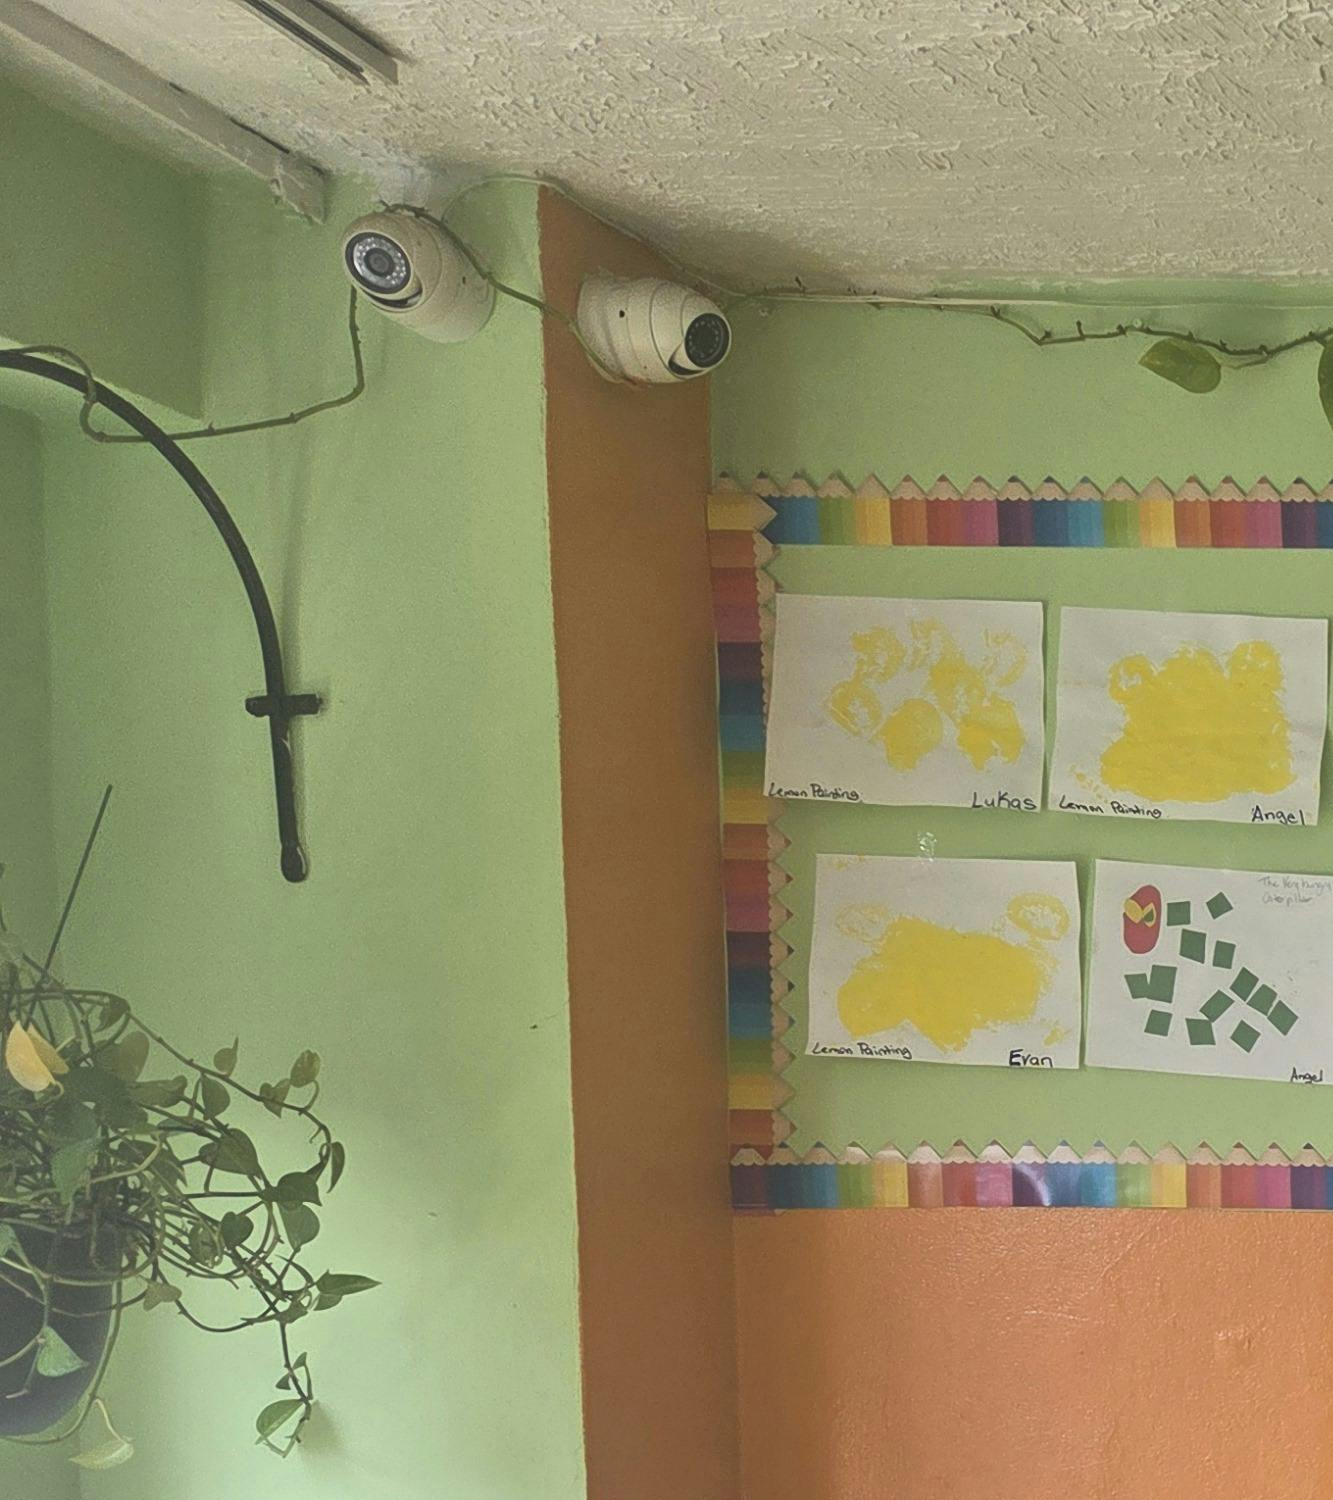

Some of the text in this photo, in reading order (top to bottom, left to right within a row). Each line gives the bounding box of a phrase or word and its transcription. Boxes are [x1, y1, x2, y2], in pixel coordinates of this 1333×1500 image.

[768, 782, 860, 802] Lemon Painting
[1059, 795, 1163, 820] Lemon Painting
[1251, 806, 1305, 825] Angel
[811, 1041, 913, 1060] Lemon Painting
[1009, 1051, 1054, 1068] Evan
[1290, 1067, 1324, 1083] Angel
